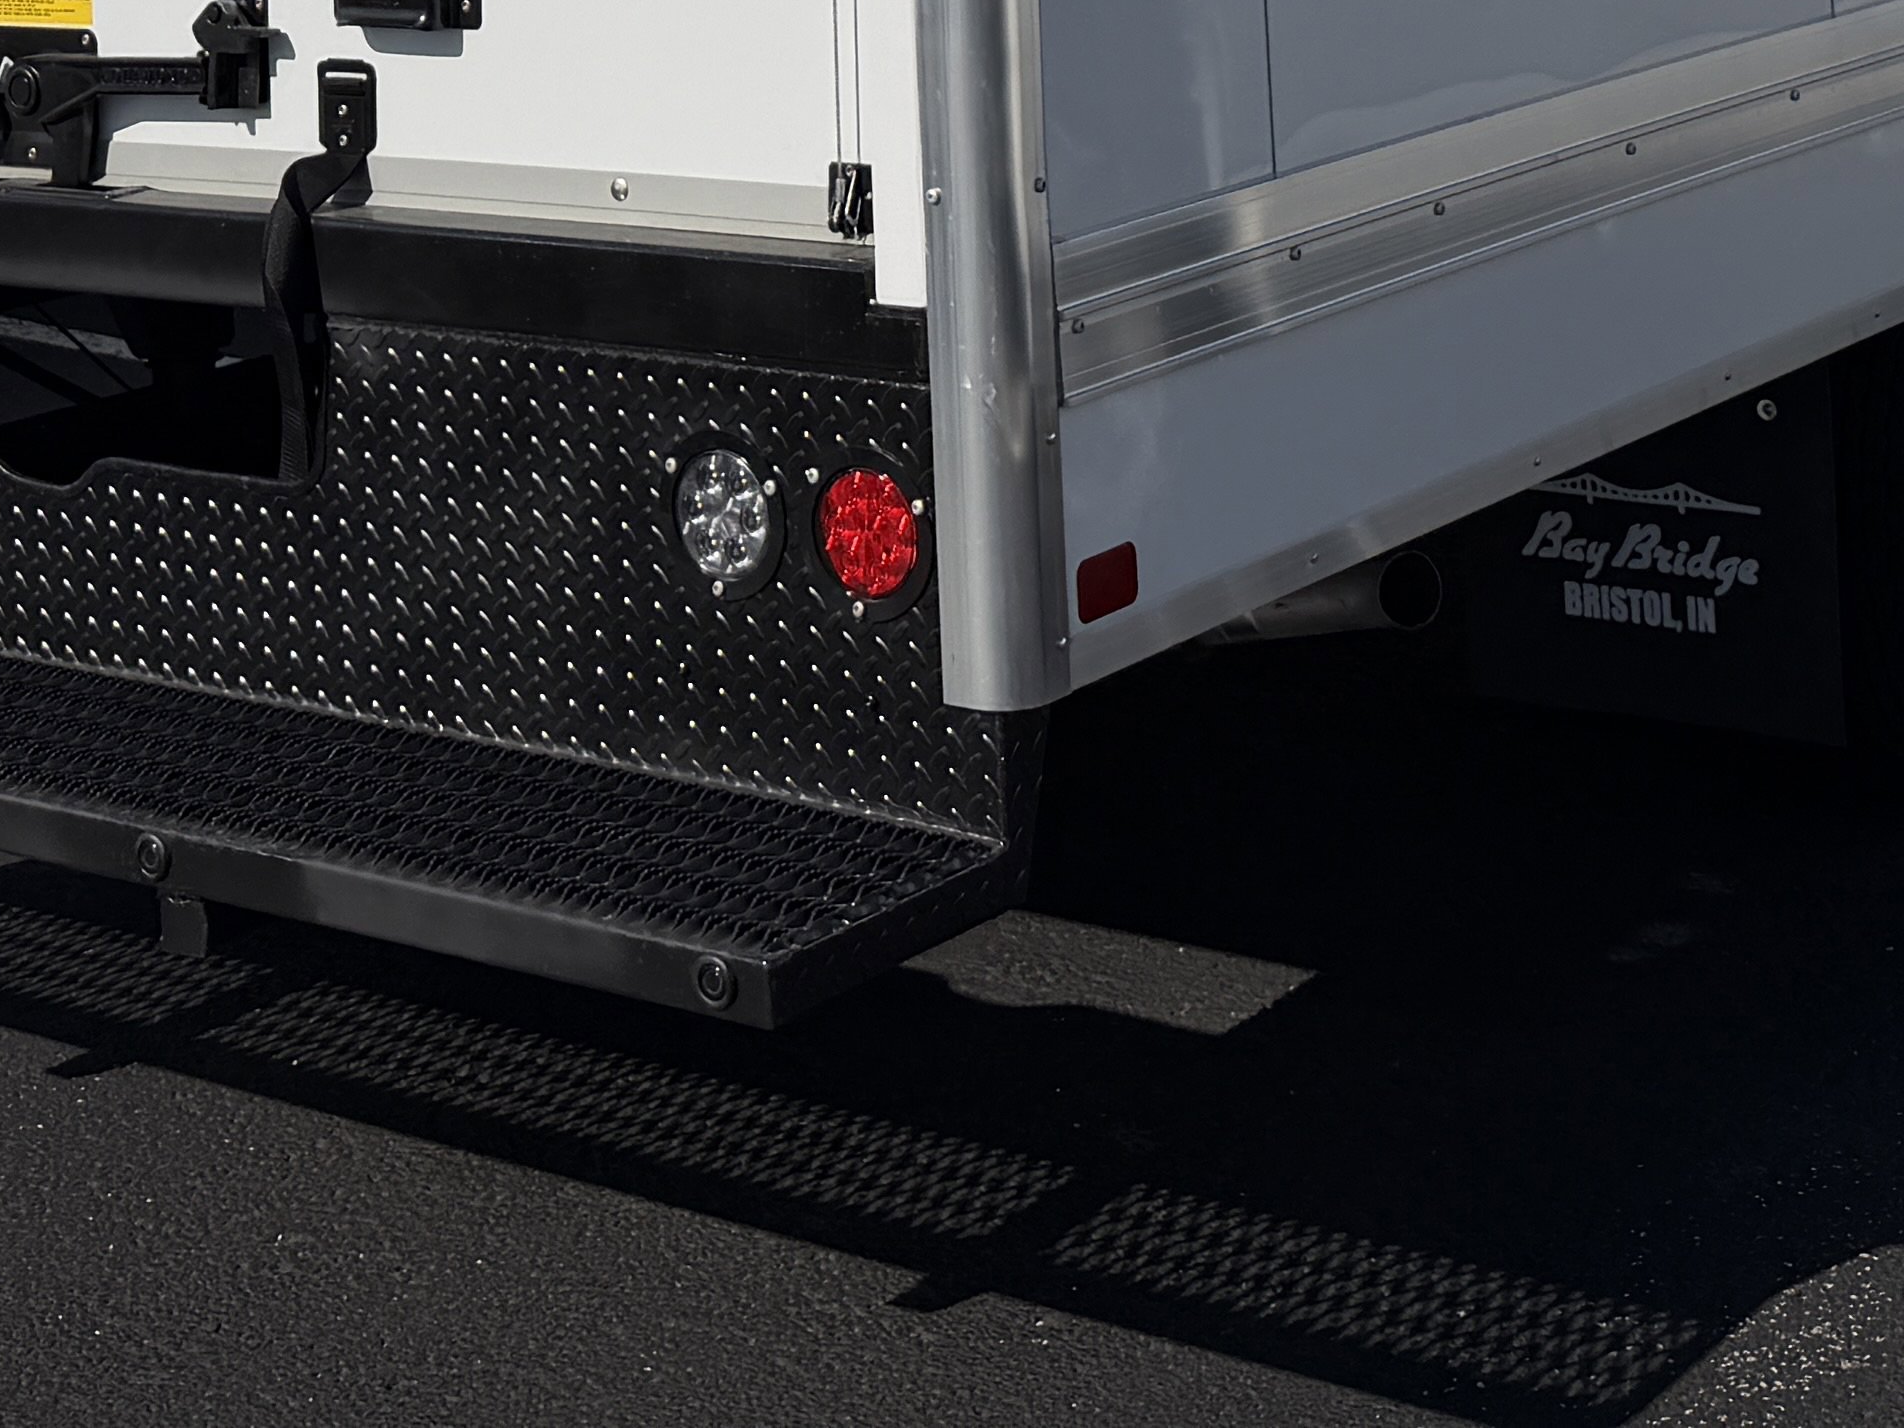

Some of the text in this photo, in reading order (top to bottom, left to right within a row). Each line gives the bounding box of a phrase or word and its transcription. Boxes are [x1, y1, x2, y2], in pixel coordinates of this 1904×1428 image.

[1521, 510, 1760, 596] Bay Bridge
[1563, 580, 1717, 634] BRISTOL, IN
